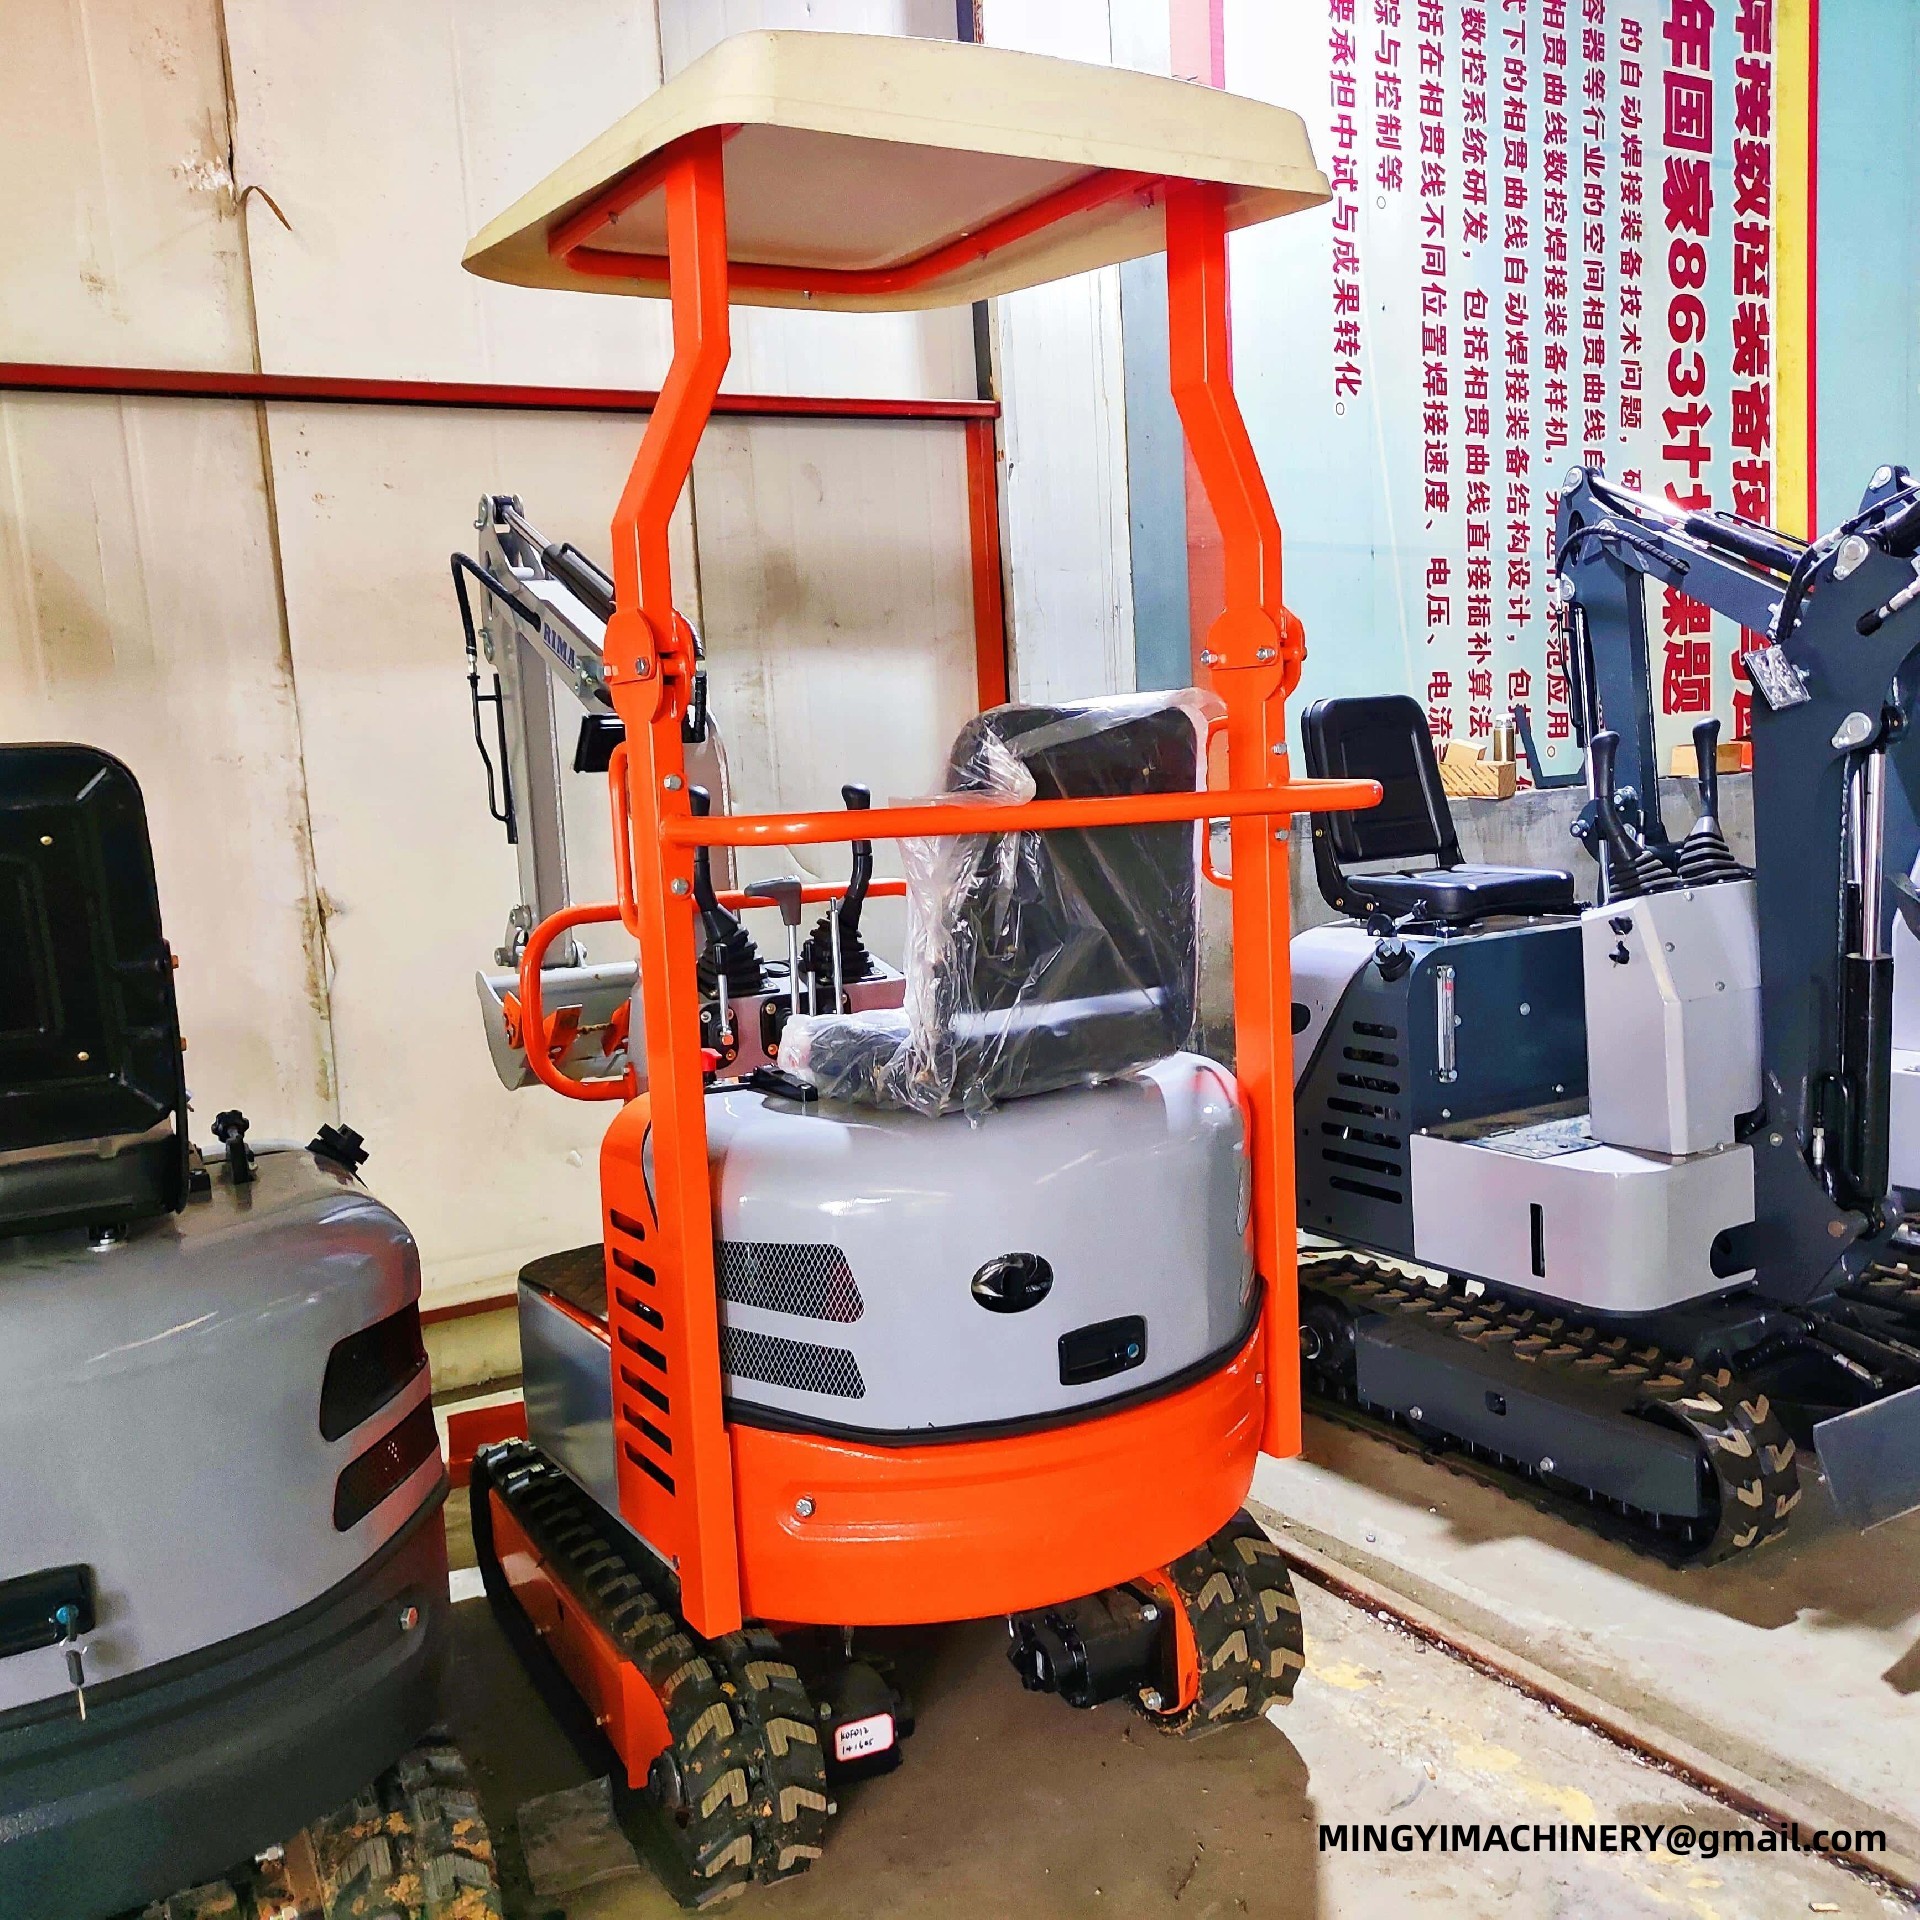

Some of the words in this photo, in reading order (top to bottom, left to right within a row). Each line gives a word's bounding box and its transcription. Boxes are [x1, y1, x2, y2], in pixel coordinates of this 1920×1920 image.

[1460, 0, 1493, 738] 数控系统研发，包括相贯曲线直接插补算法
[543, 622, 575, 670] RIMA
